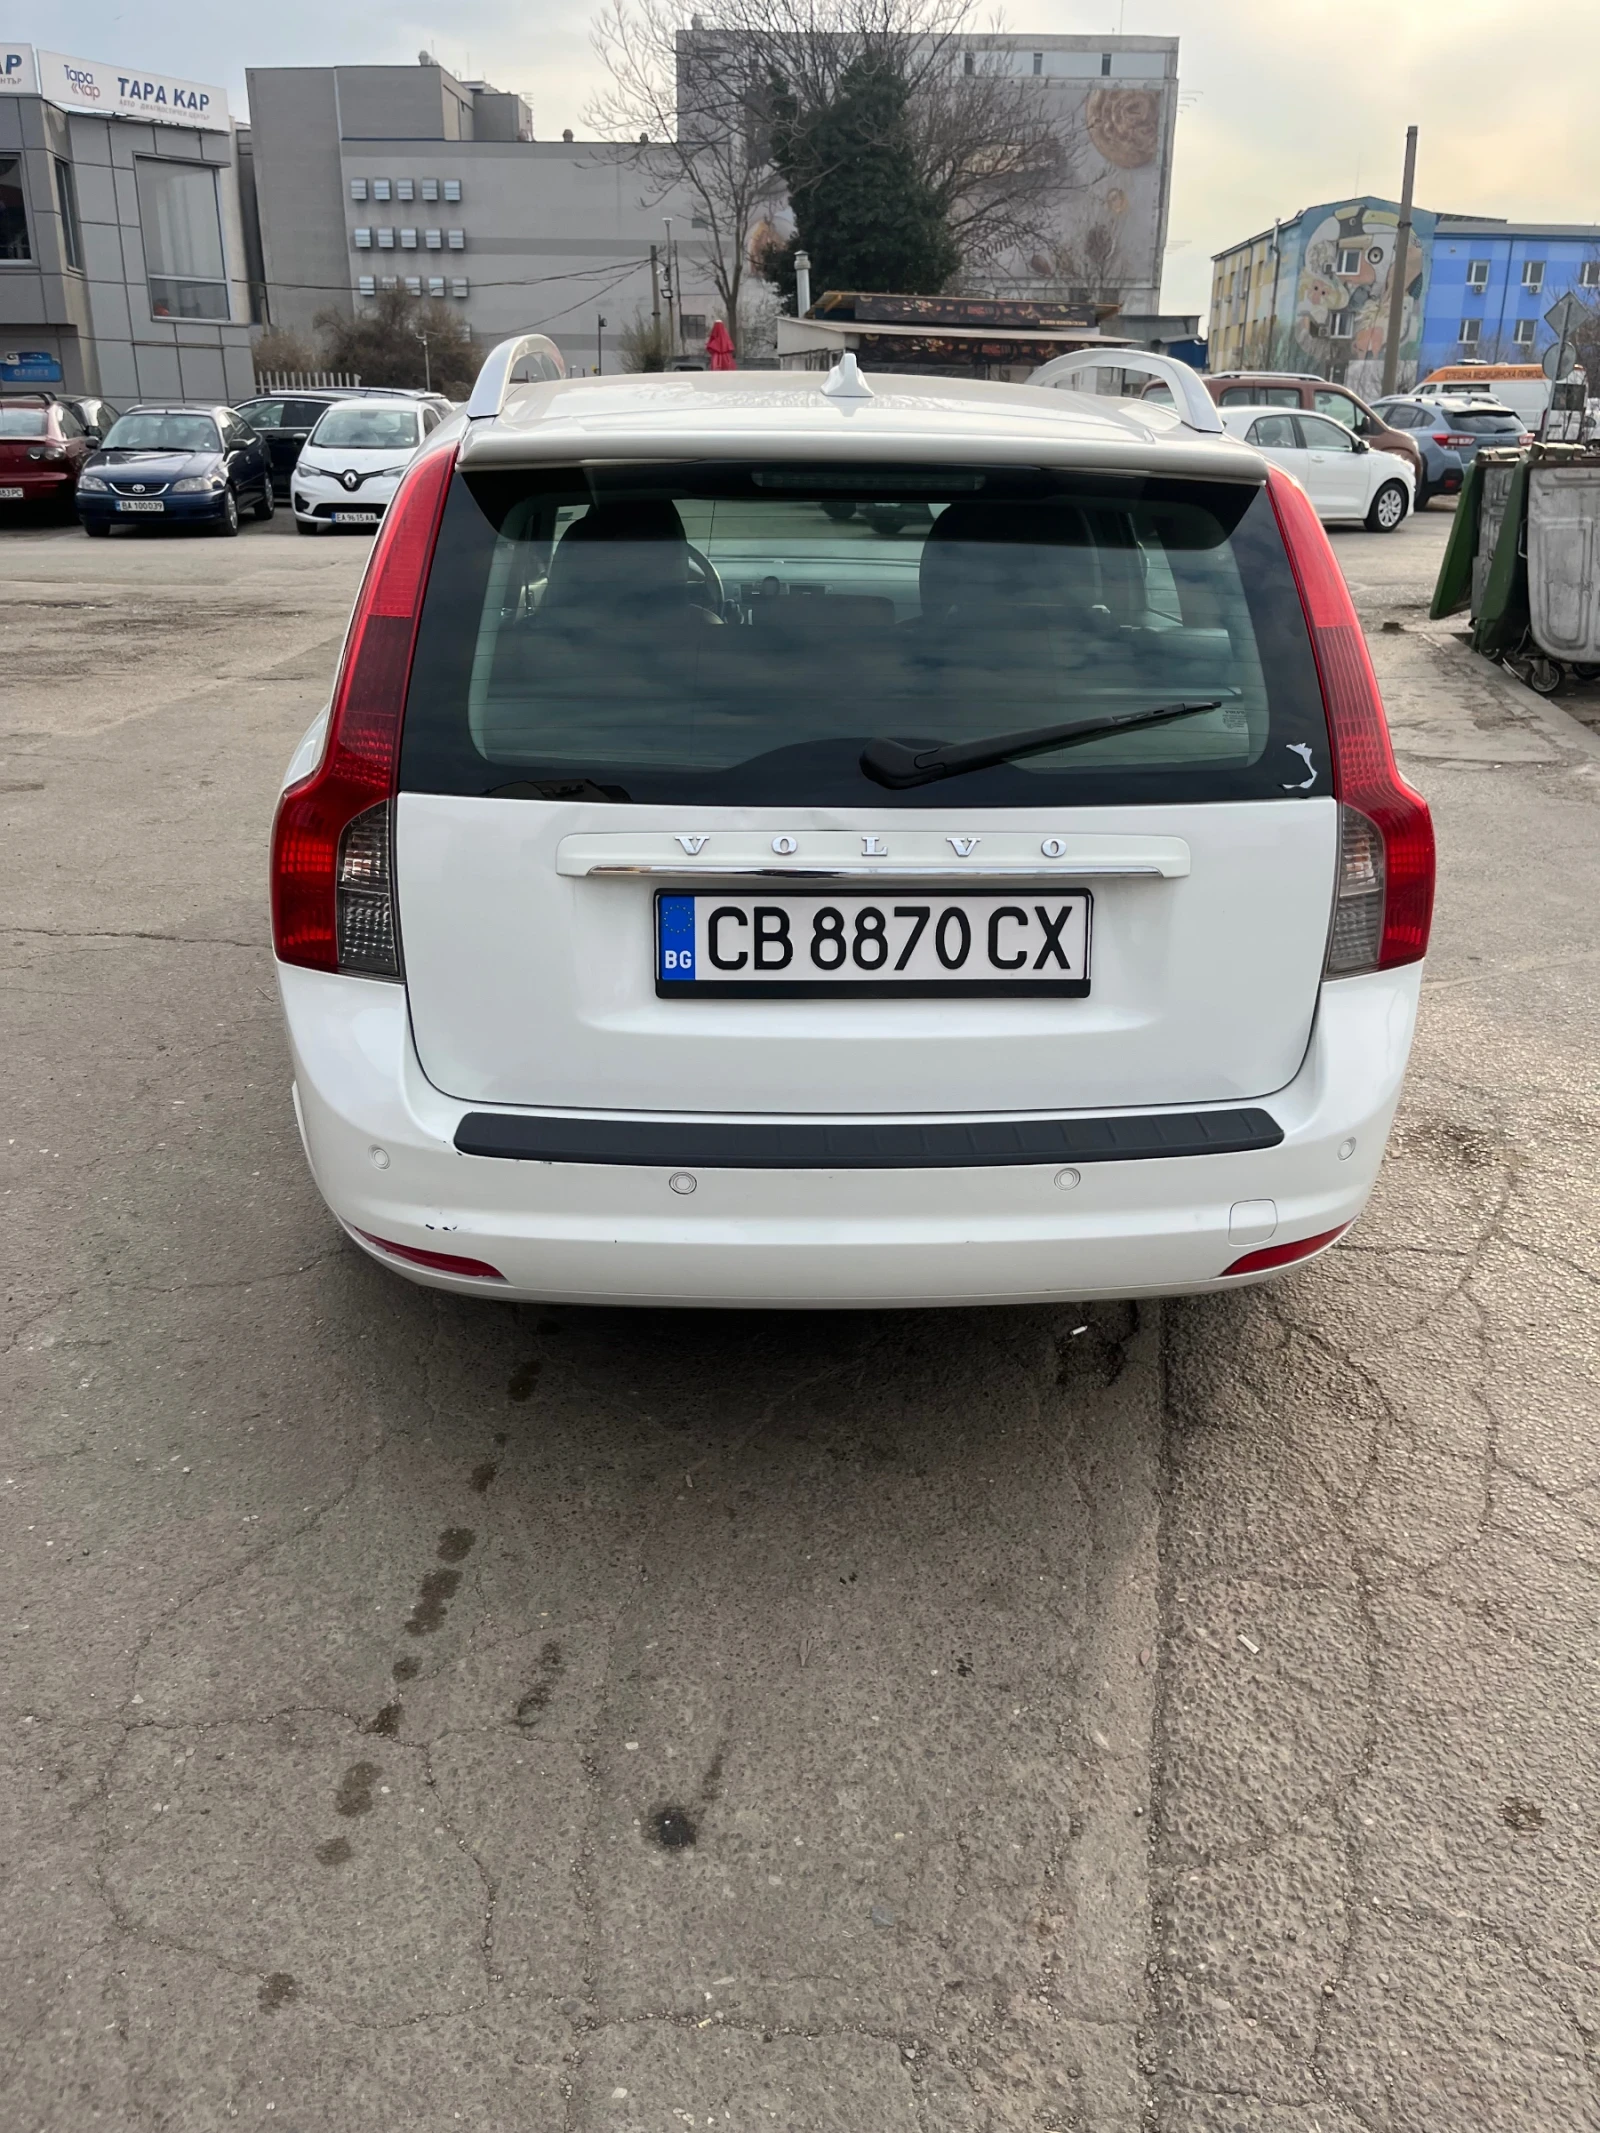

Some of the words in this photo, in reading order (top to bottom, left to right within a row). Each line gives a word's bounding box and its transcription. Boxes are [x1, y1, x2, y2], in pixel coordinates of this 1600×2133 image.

[0, 54, 22, 74] Р
[117, 77, 167, 104] ТАРА
[174, 88, 210, 111] КАР
[675, 835, 1068, 858] VOLVO
[708, 906, 794, 971] CB
[810, 906, 972, 971] 8870
[988, 906, 1073, 971] CX
[664, 949, 692, 969] BG
